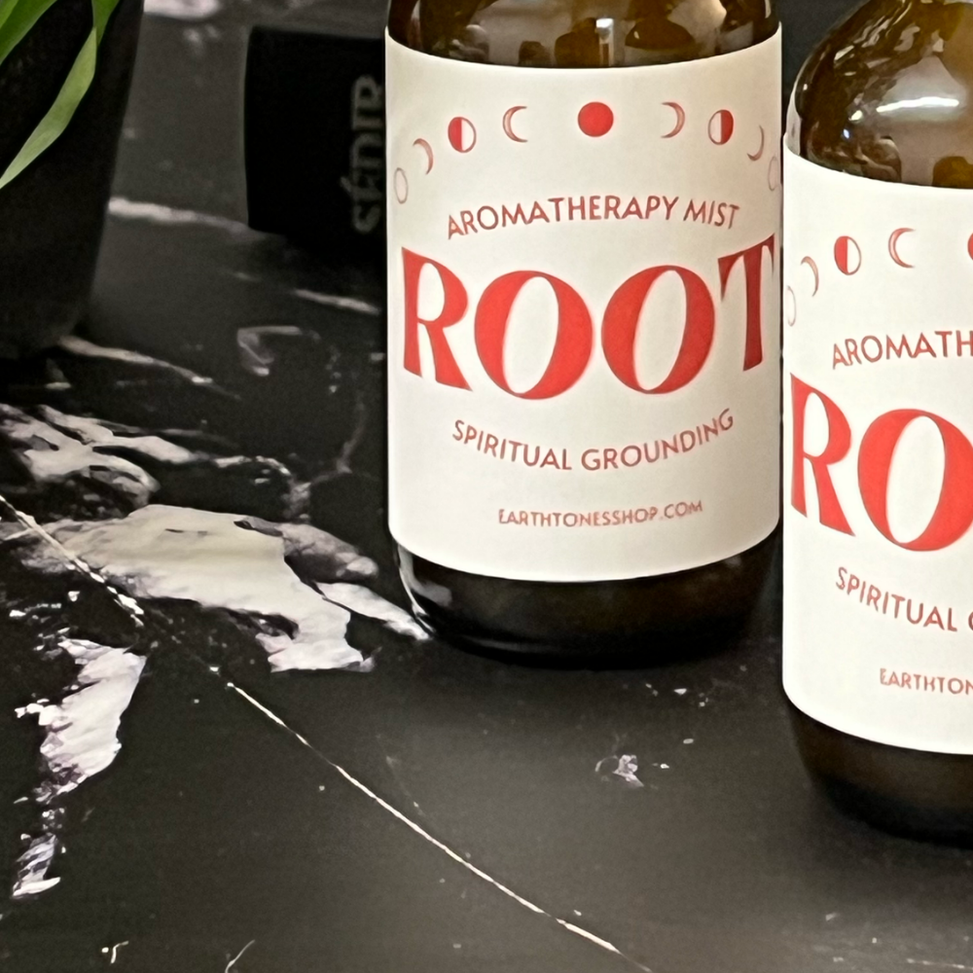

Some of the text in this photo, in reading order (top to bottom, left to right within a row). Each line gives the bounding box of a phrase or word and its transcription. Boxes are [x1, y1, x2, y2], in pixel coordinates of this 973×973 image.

[447, 195, 741, 240] AROMATHERAPY MIST
[401, 232, 775, 400] ROOT
[452, 407, 735, 471] SPIRITUAL GROUNDING
[497, 499, 704, 527] EARTHTONESSHOP.COM
[835, 566, 958, 633] SPIRITUAL
